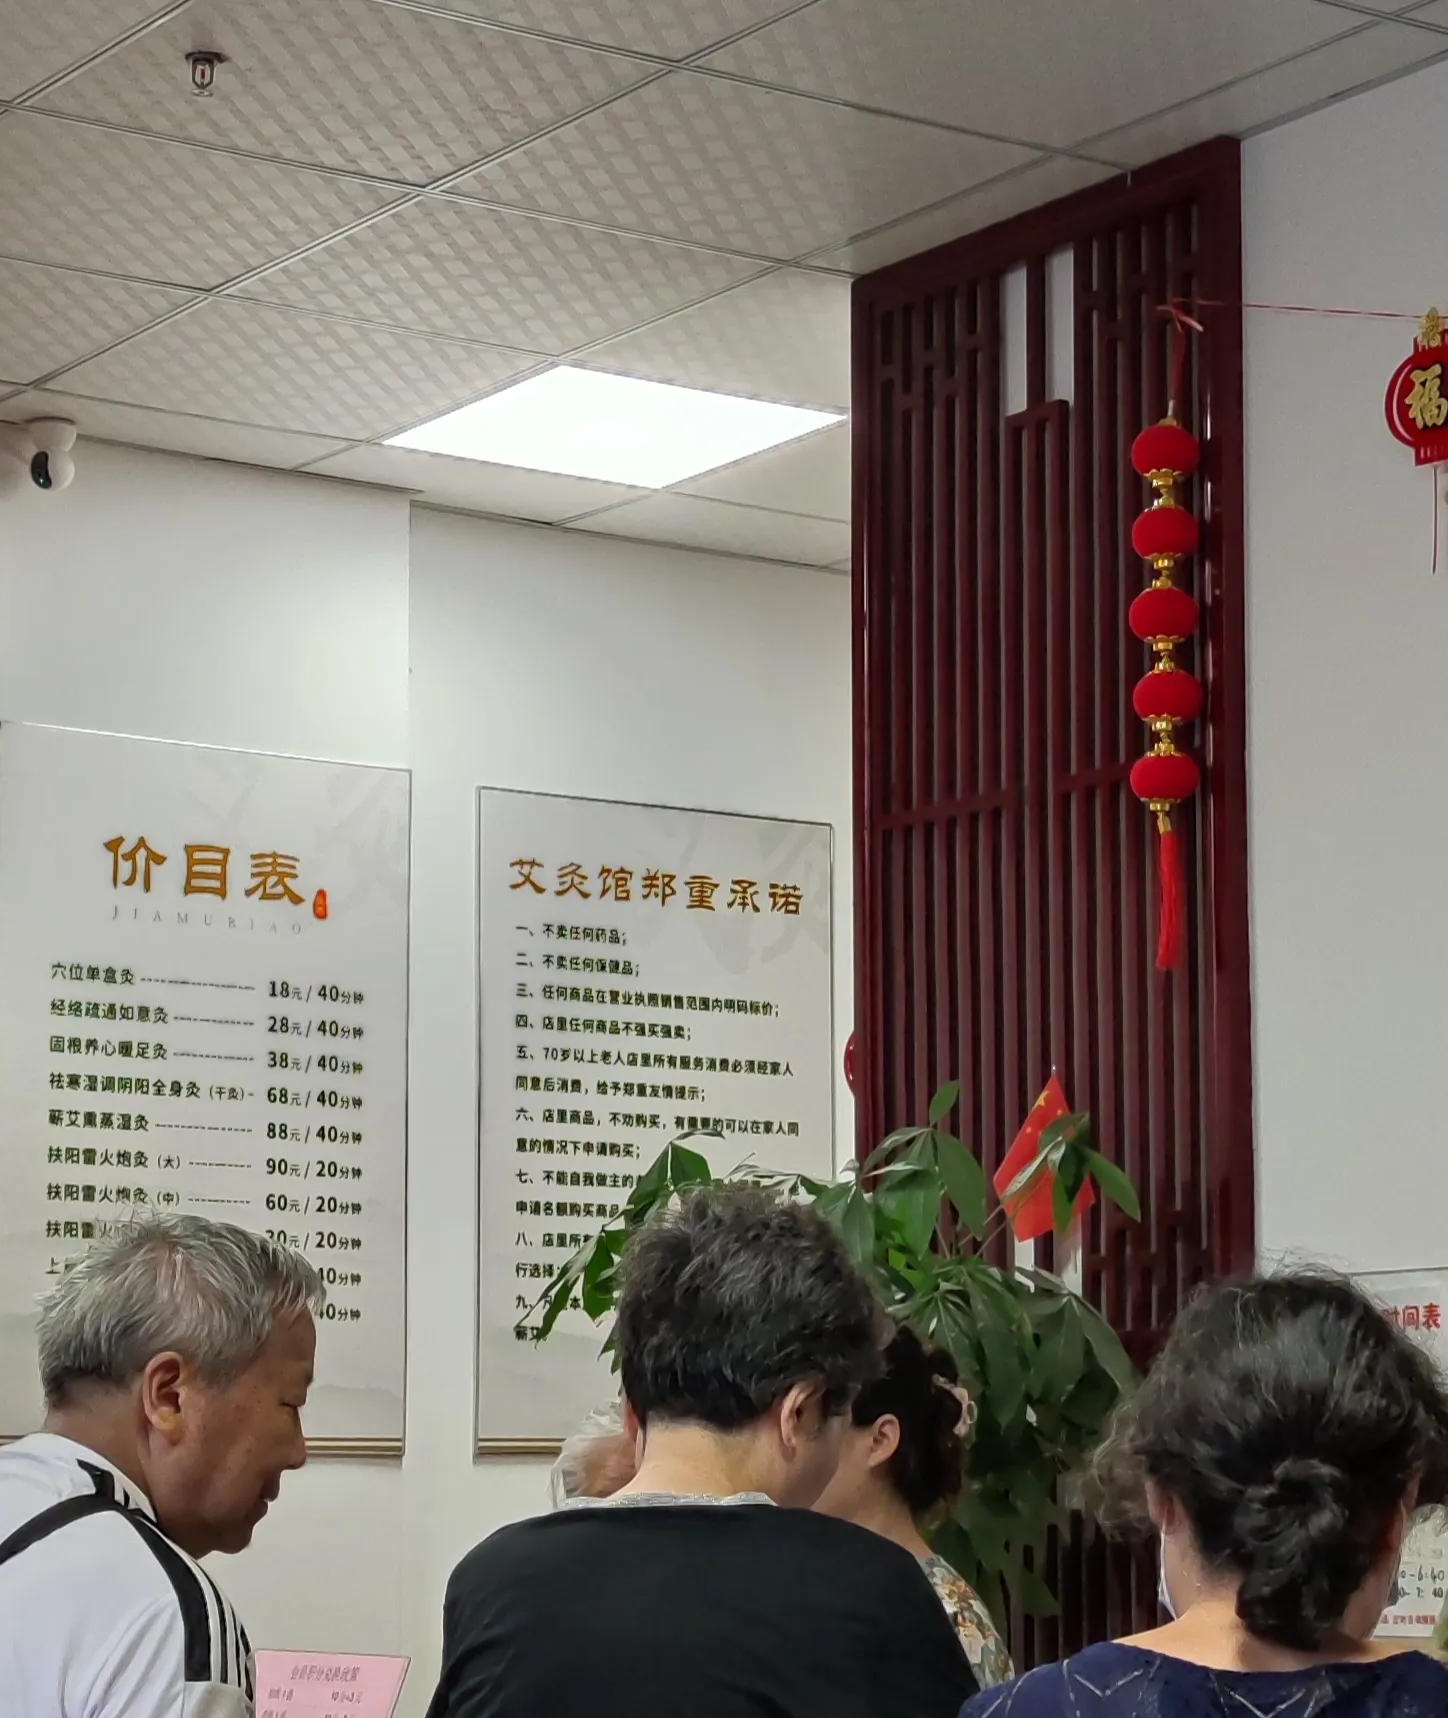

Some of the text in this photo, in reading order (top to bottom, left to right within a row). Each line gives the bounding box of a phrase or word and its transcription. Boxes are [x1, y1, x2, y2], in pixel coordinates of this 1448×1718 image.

[103, 835, 306, 906] 价目表
[509, 858, 804, 916] 艾灸馆郑重承诺
